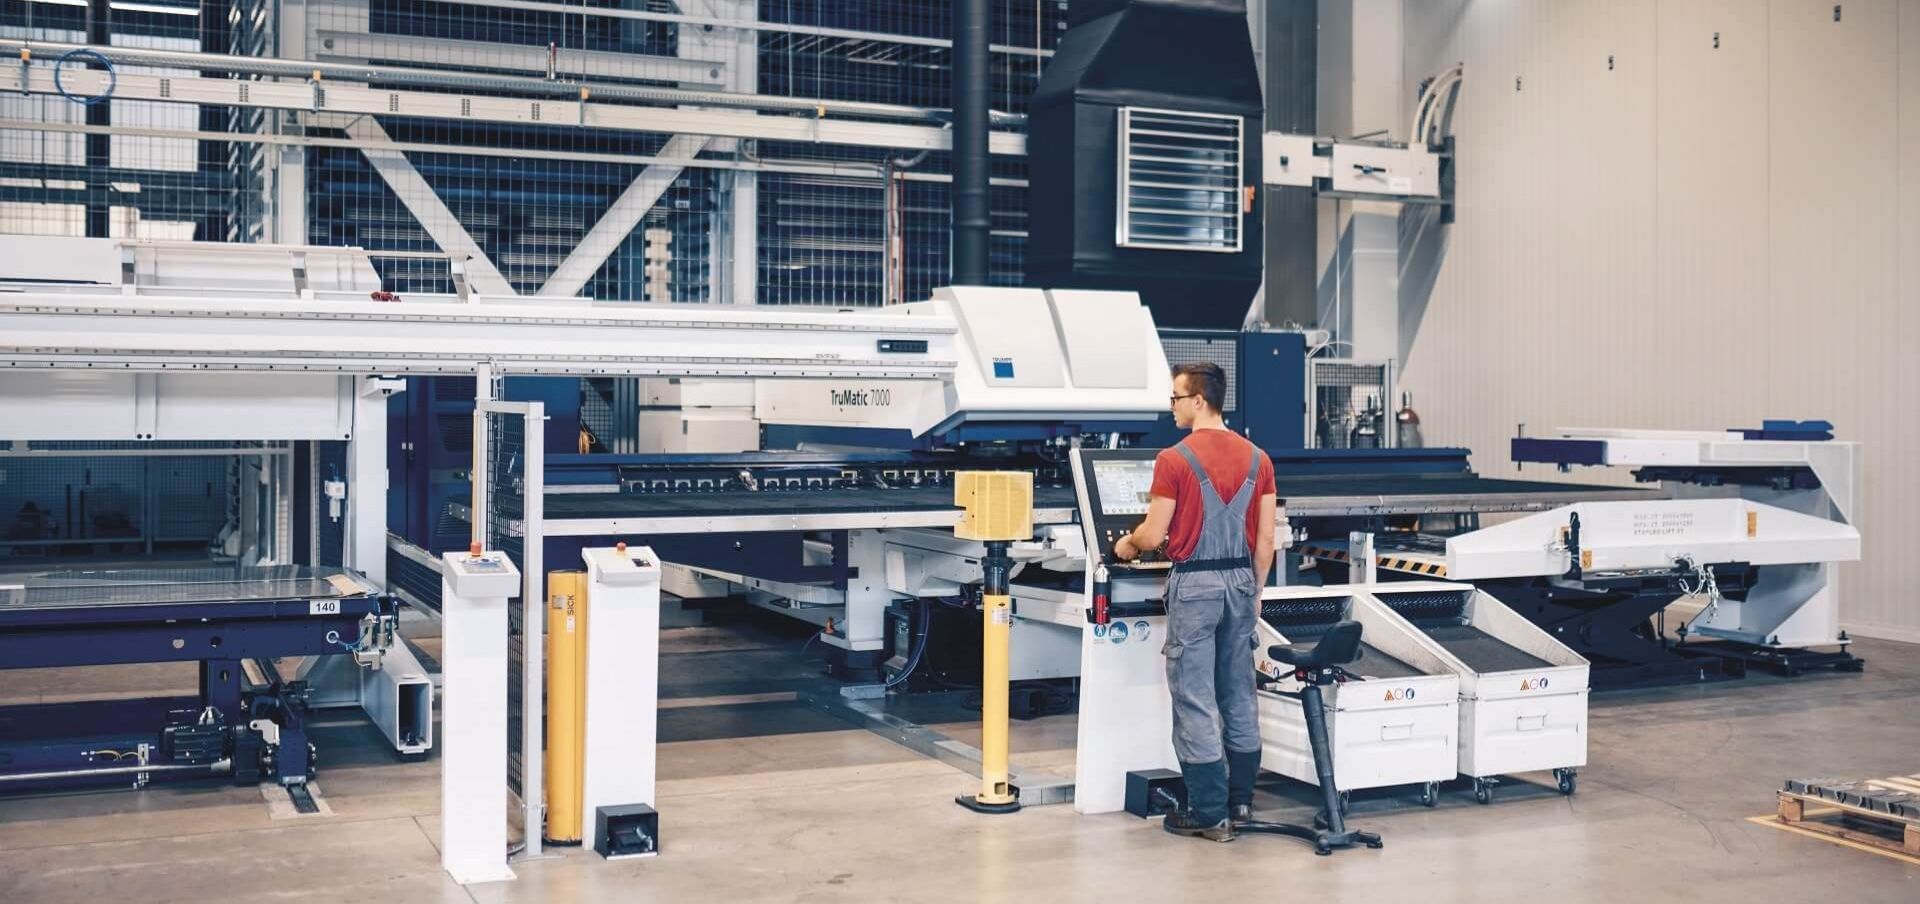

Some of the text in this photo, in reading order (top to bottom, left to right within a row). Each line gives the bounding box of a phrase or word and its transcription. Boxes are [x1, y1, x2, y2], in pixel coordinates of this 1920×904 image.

[831, 388, 890, 406] TruMatic 7000
[316, 602, 335, 612] 140
[567, 594, 575, 616] SICK
